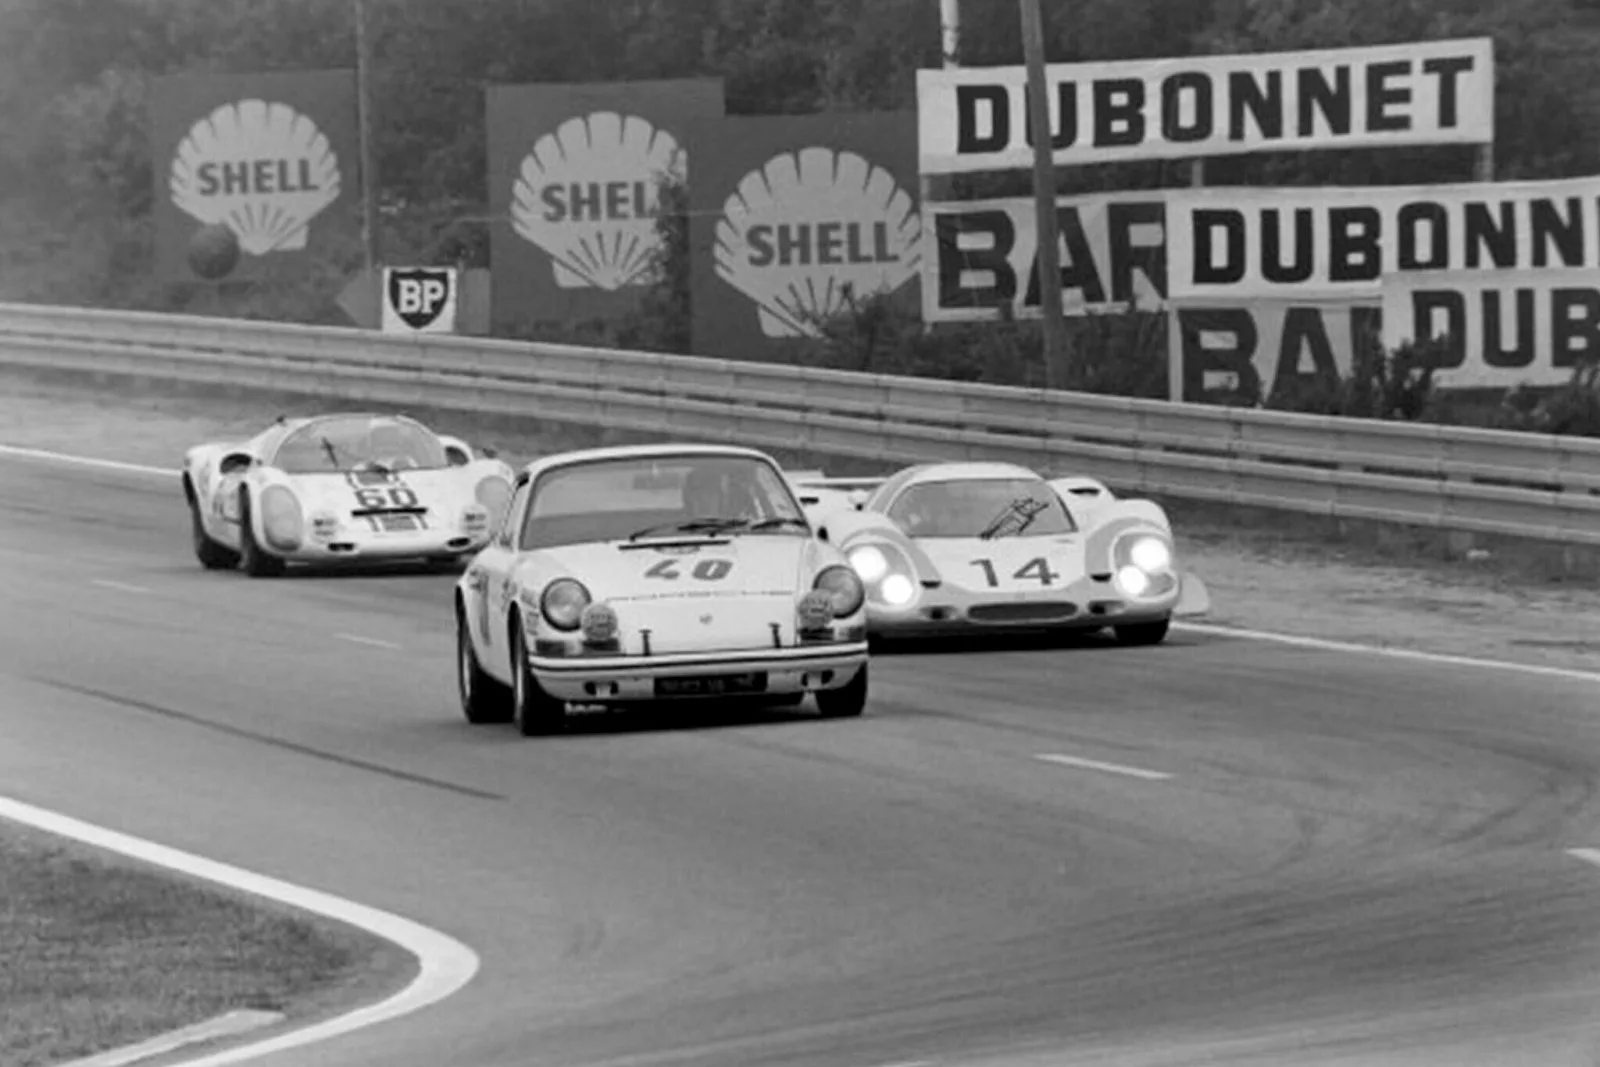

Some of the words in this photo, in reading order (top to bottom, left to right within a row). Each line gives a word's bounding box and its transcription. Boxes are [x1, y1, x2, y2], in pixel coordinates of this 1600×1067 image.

[956, 55, 1475, 155] DUBONNET
[199, 159, 320, 195] SHELL
[540, 177, 659, 222] SHEL
[745, 221, 899, 266] SHELL
[1191, 196, 1600, 285] DUBONN
[398, 279, 443, 315] BP
[1411, 287, 1600, 369] DUB
[354, 488, 418, 511] 60
[970, 557, 1060, 587] 14
